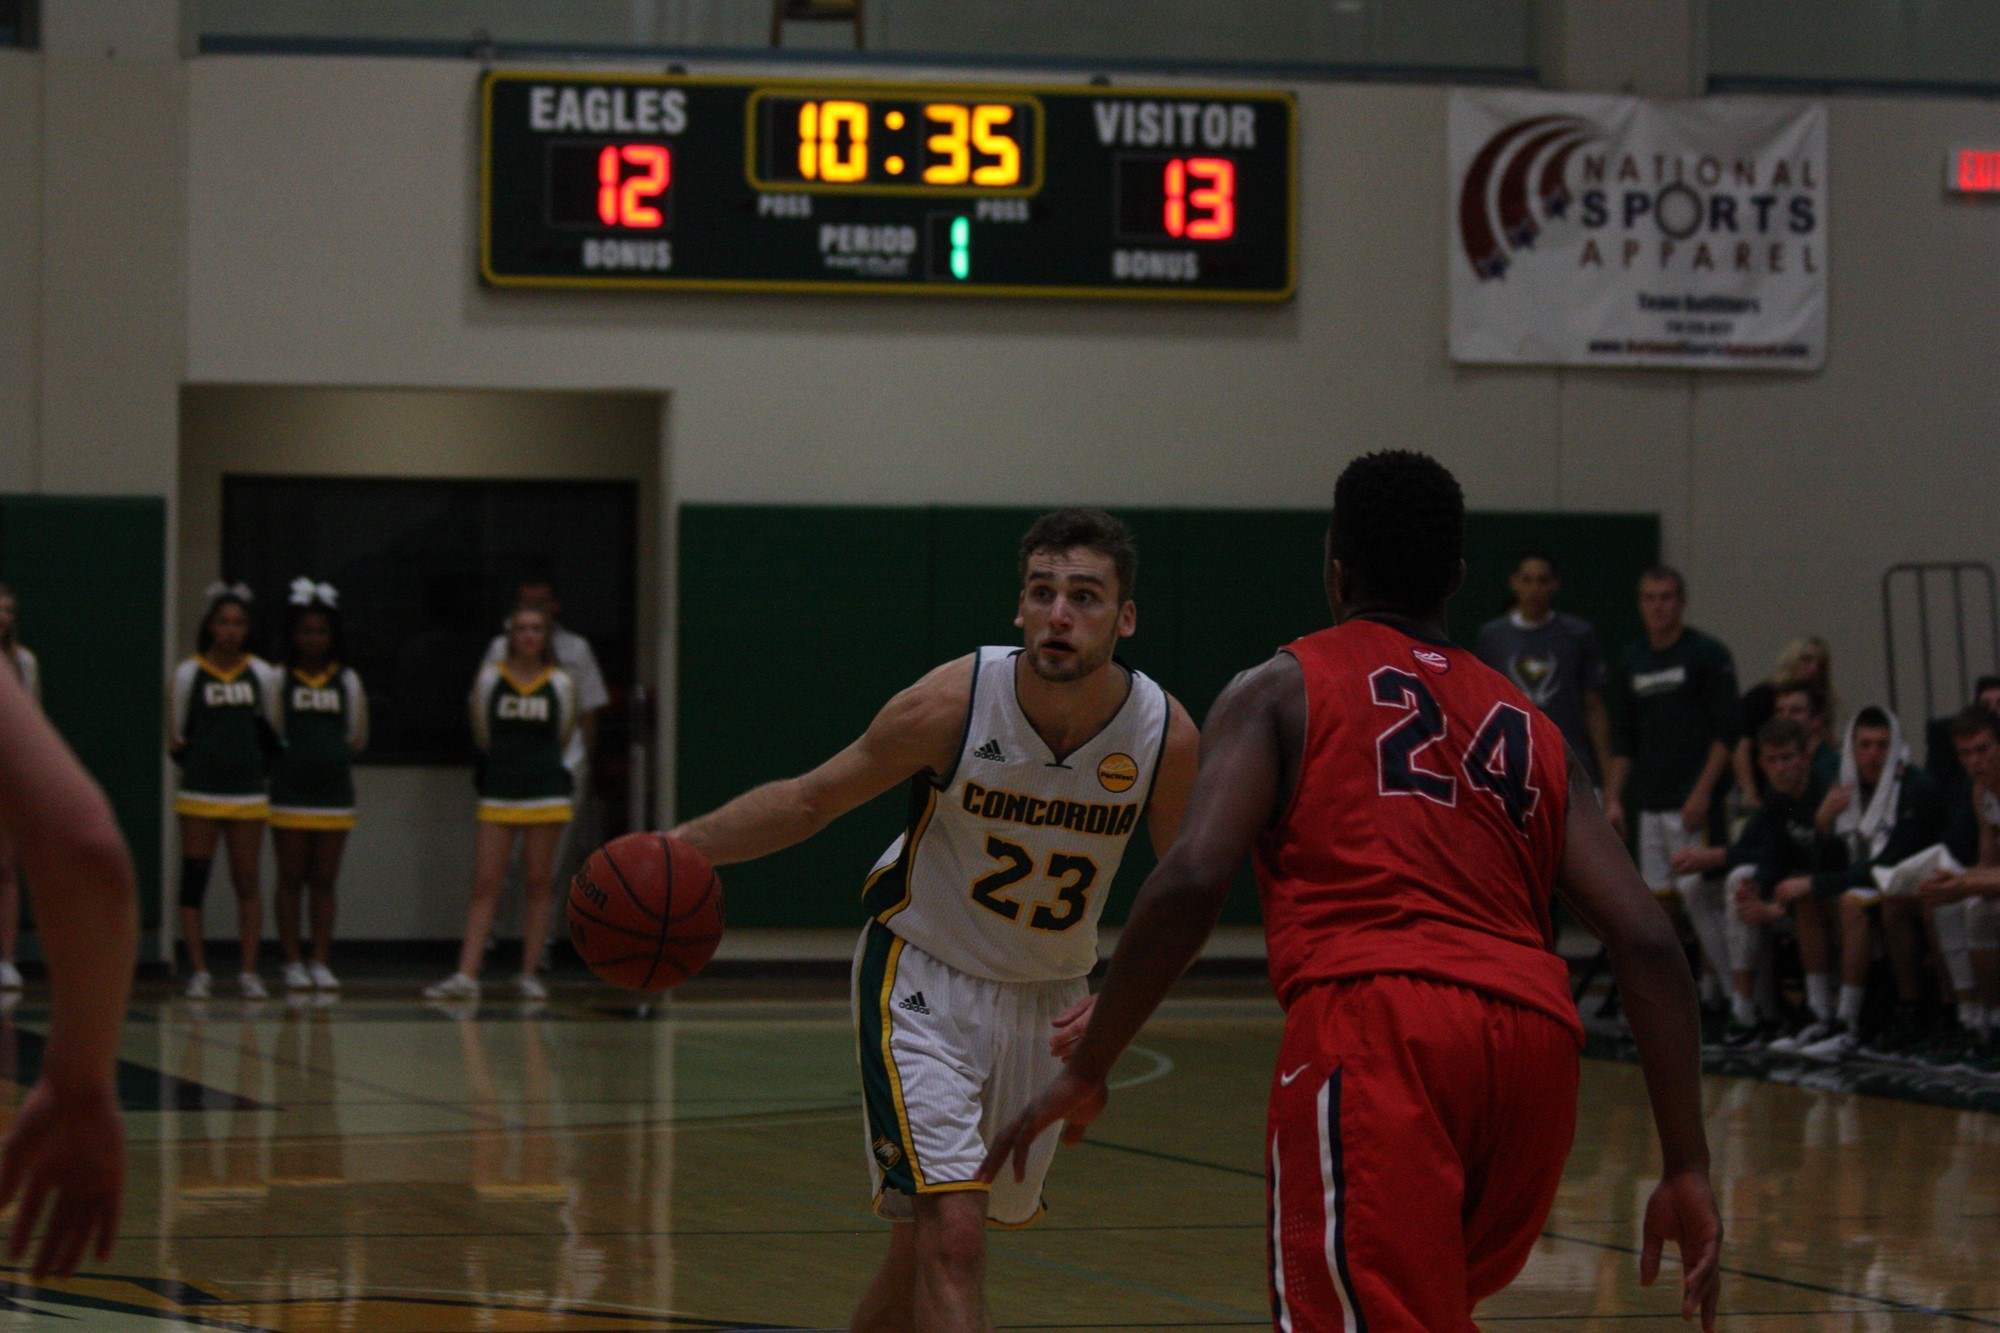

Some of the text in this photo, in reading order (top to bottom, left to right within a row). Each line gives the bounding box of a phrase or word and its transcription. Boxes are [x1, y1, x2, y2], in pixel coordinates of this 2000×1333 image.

[529, 86, 687, 134] EAGLES
[1094, 103, 1256, 147] VISITOR
[799, 101, 1021, 186] 10:35
[598, 144, 671, 228] 12
[1583, 153, 1817, 189] NATIONAL
[1164, 157, 1235, 240] 13
[1582, 182, 1816, 240] SPORTS
[582, 239, 671, 269] BONUS
[819, 223, 917, 254] PERIOD
[949, 216, 970, 279] 1
[1579, 238, 1818, 274] APPAREL
[1112, 250, 1198, 281] BONUS
[973, 750, 1006, 763] adidas
[1367, 665, 1540, 838] 24
[962, 781, 1138, 836] CONCORDIA
[970, 832, 1098, 934] 23
[899, 1001, 930, 1015] adidas
